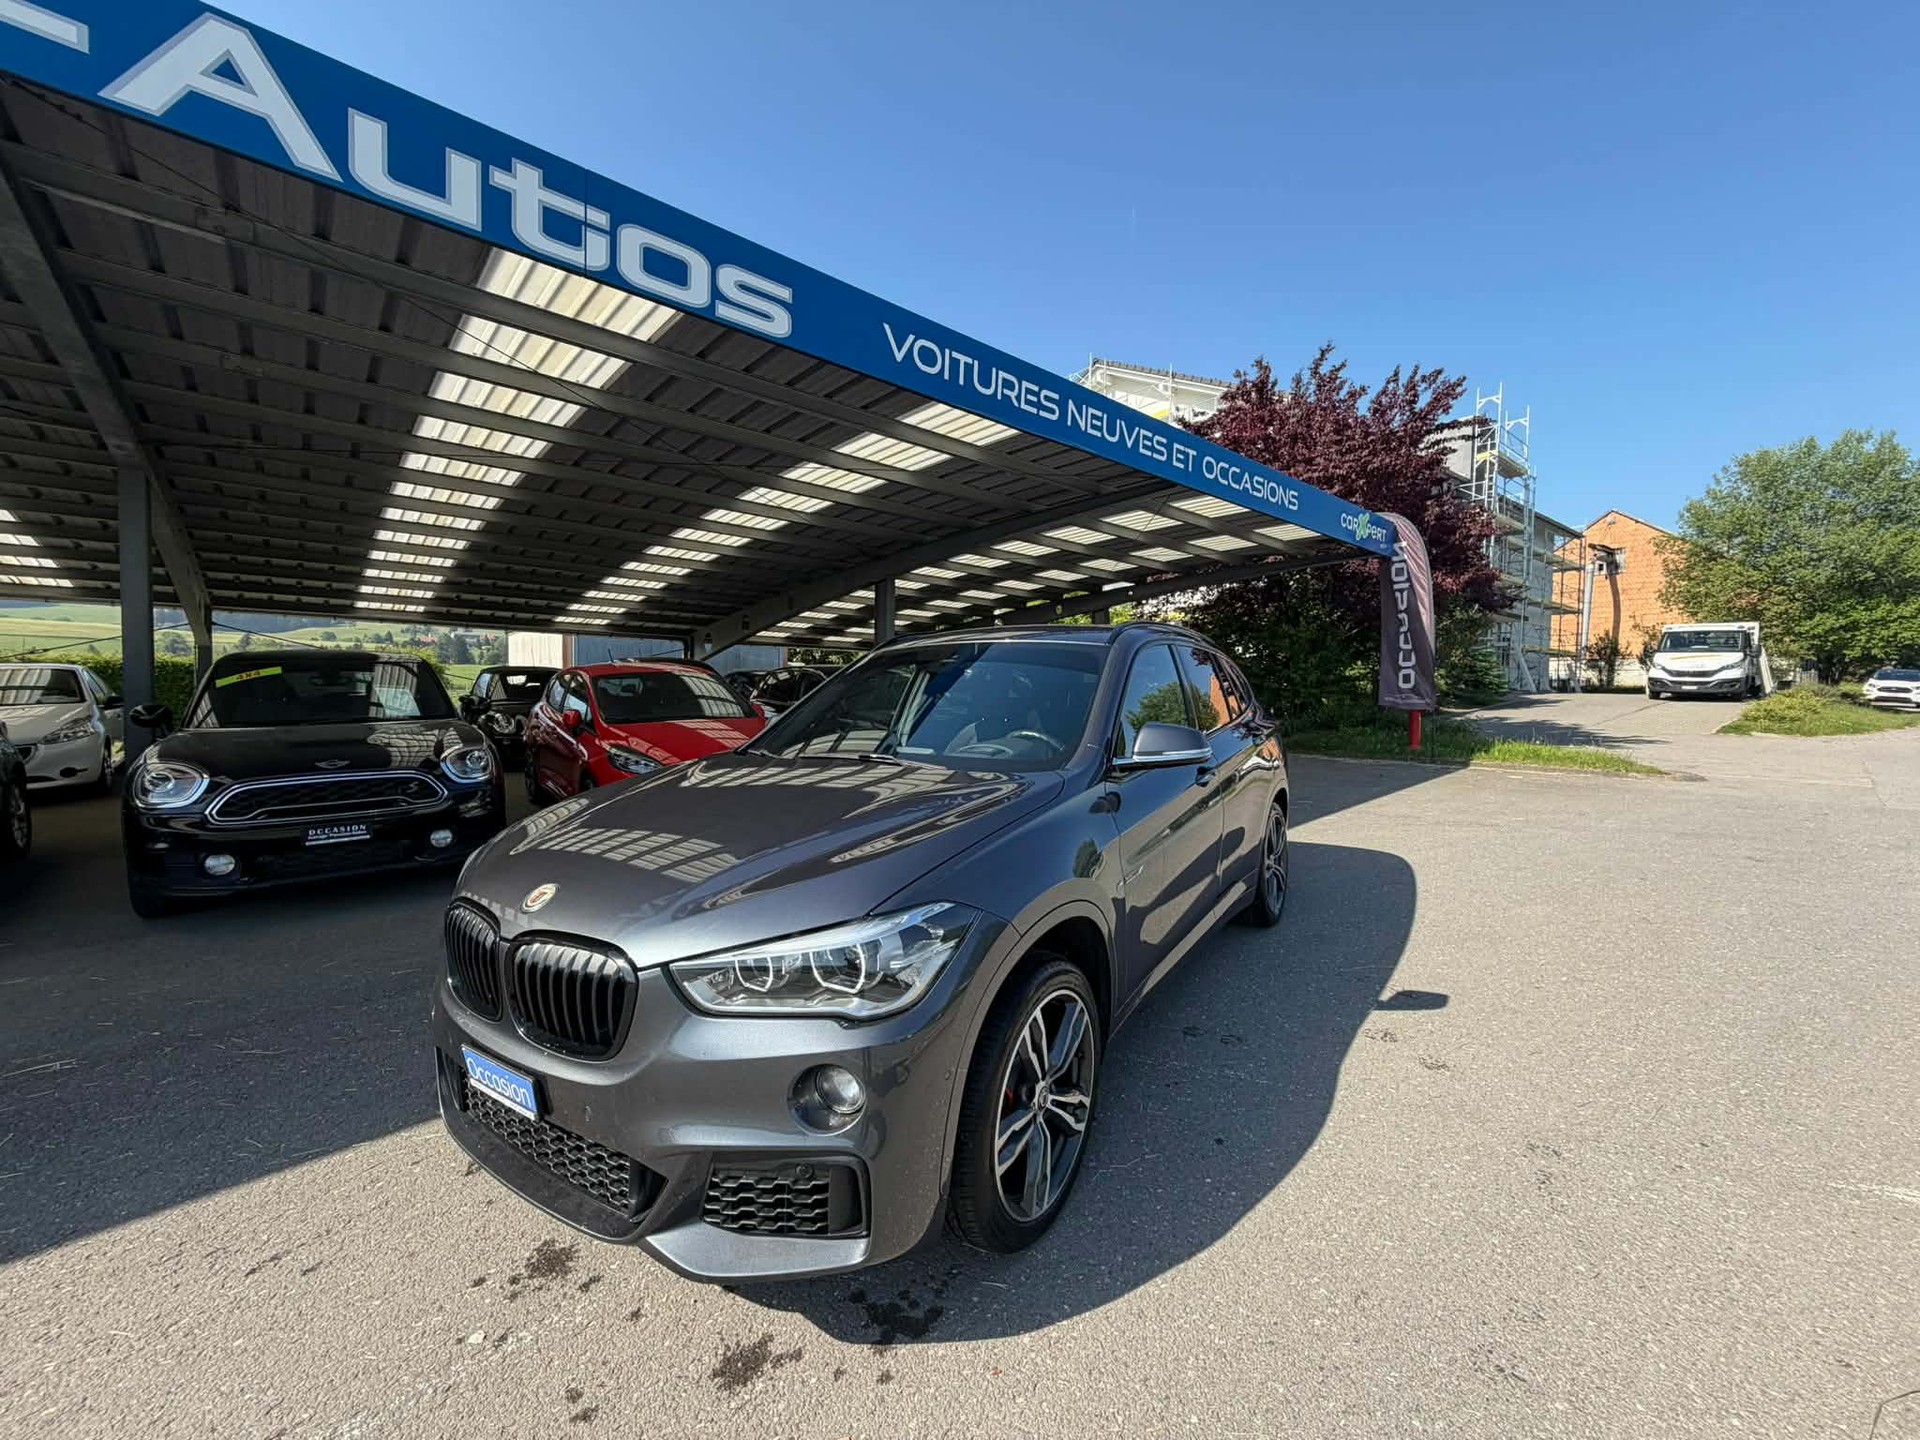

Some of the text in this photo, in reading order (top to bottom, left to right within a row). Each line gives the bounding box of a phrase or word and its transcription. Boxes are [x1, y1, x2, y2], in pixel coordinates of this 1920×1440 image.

[98, 11, 793, 338] Autos
[882, 321, 1299, 511] VOITURES NEUVES ET OCCASIONS
[308, 824, 367, 836] OCCASION
[466, 1057, 532, 1109] Occasion
